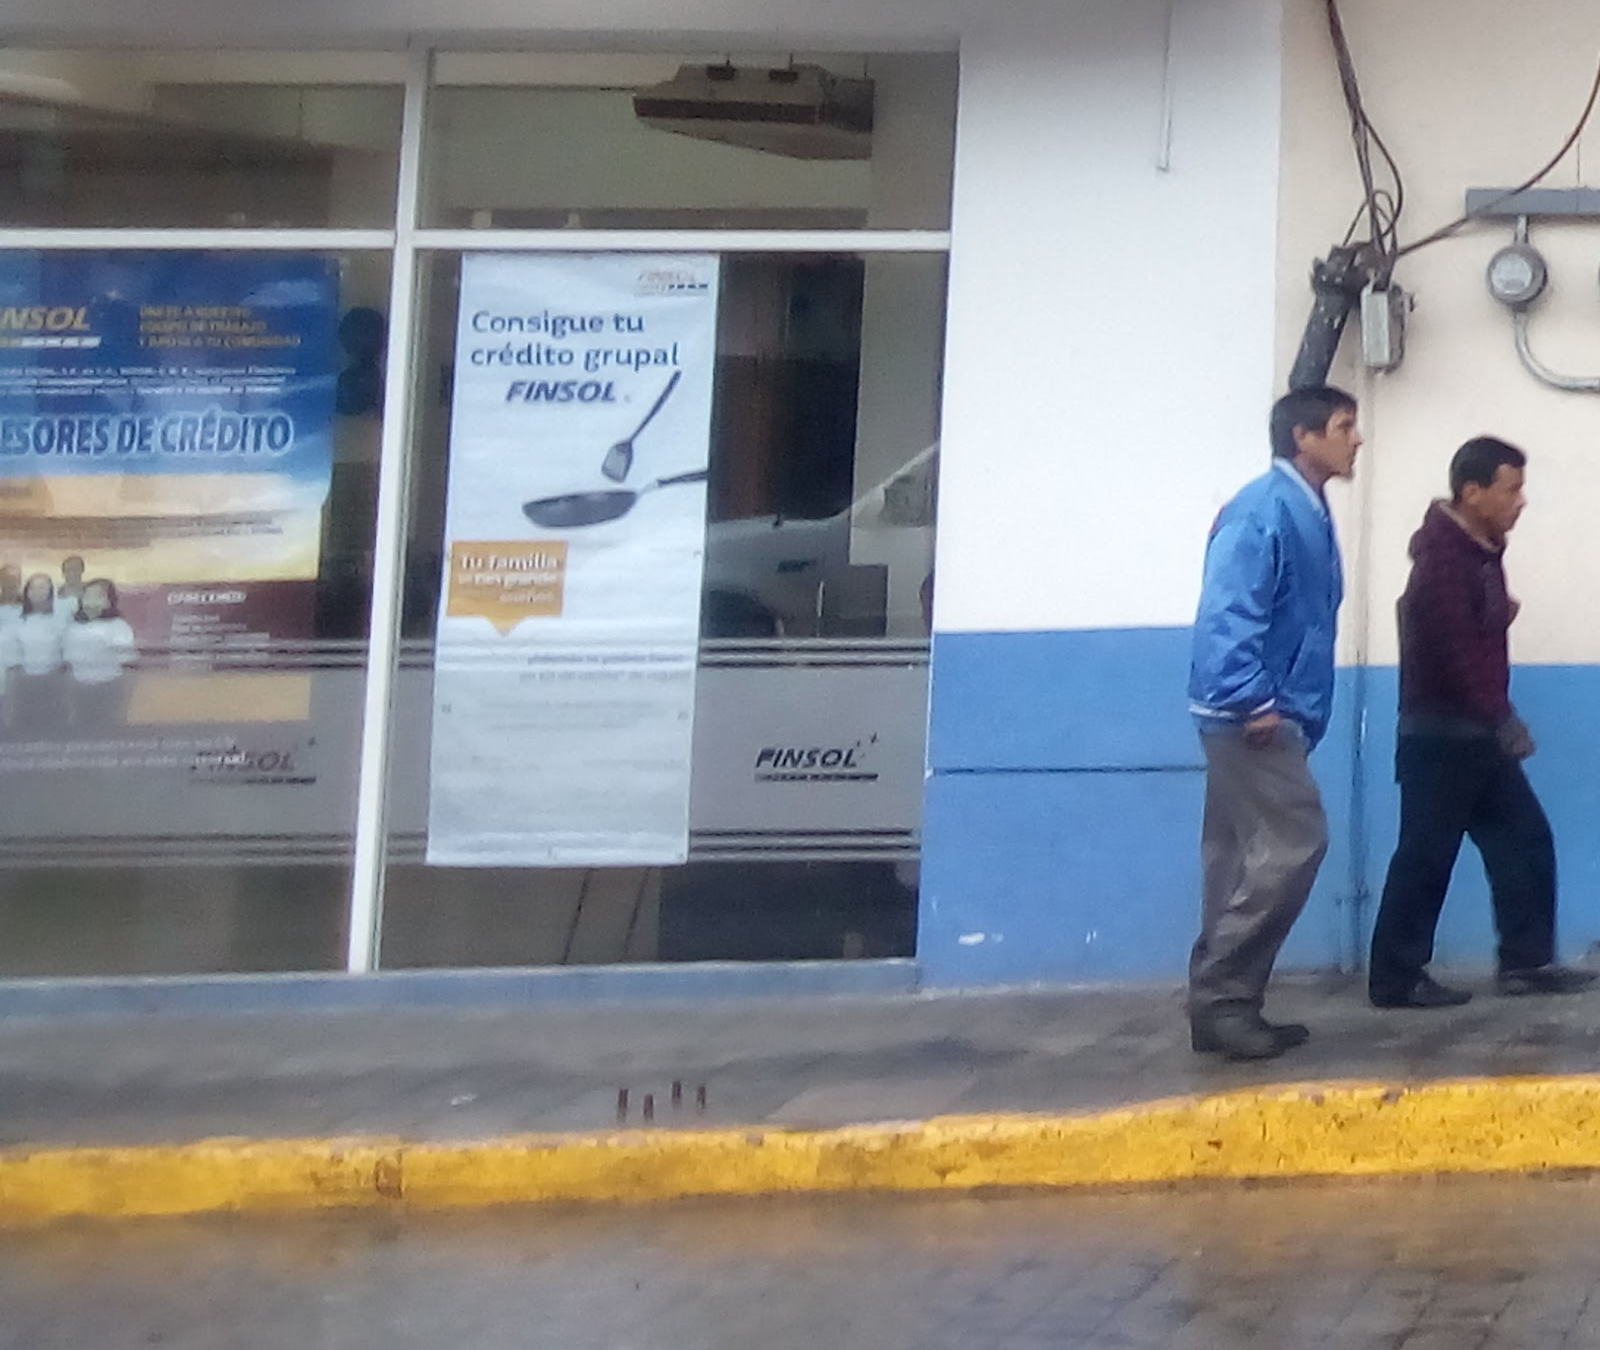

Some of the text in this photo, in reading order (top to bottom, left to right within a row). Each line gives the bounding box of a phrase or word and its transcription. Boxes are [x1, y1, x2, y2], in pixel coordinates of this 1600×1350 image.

[472, 310, 645, 340] Consigue tu
[470, 341, 680, 373] crédito grupal
[506, 380, 618, 403] FINSOL
[115, 414, 154, 455] DE
[159, 404, 294, 457] CRÉDITO
[756, 747, 857, 769] FINSOL
